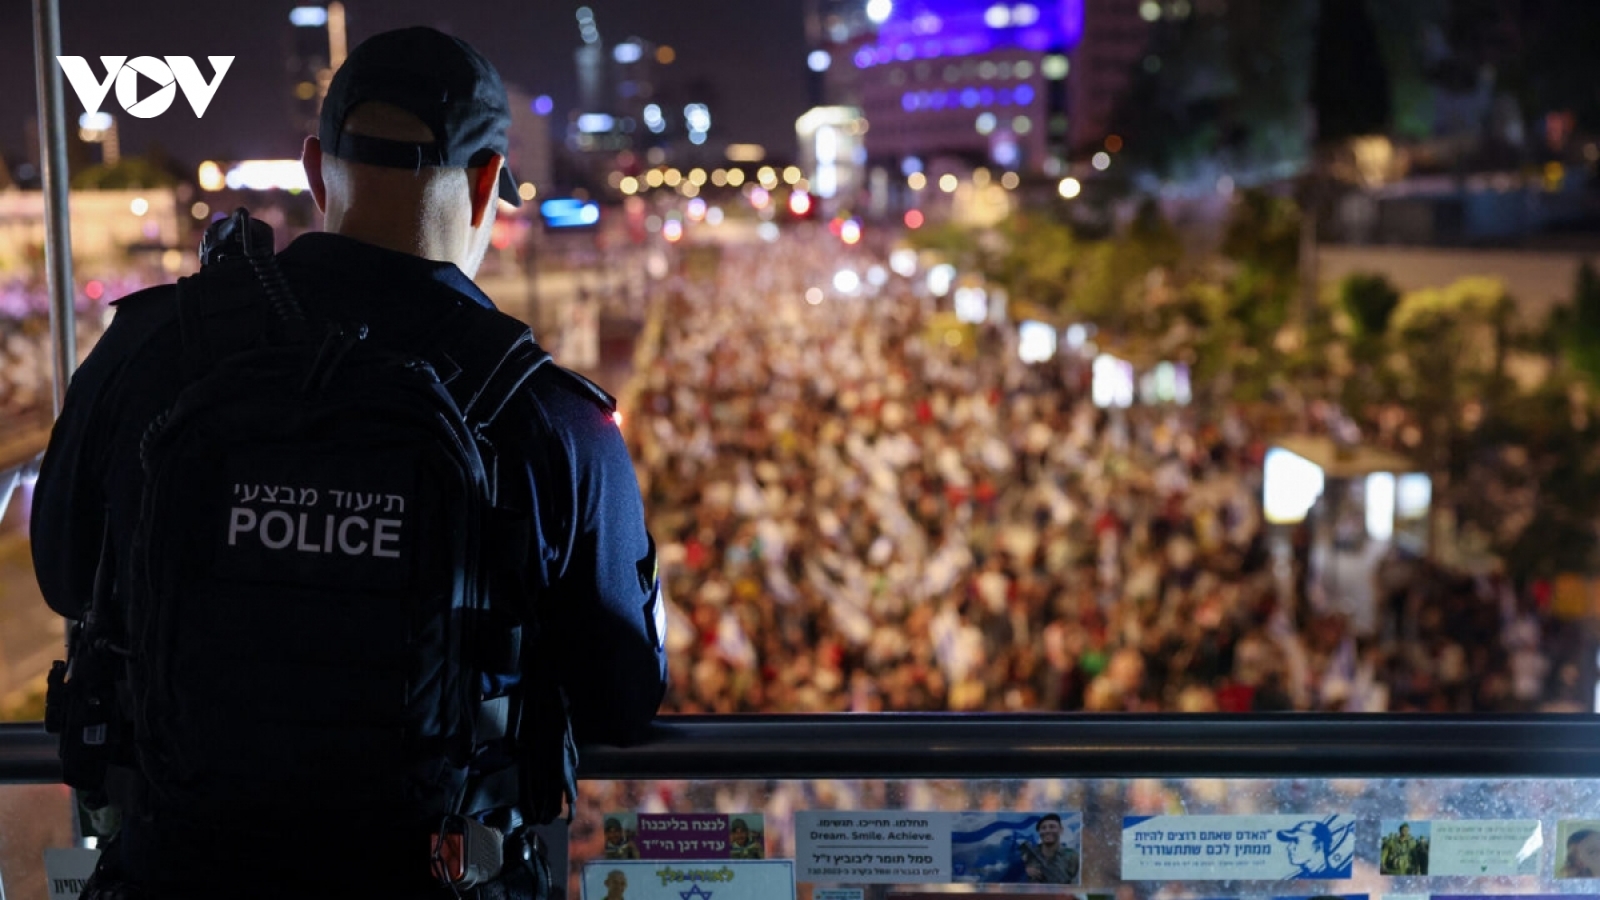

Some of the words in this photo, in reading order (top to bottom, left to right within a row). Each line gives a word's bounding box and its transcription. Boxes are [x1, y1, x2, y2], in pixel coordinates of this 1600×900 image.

[233, 483, 318, 506] מבצעי
[328, 489, 405, 513] תיעוד
[227, 507, 402, 558] POLICE
[692, 817, 726, 831] לנצח
[810, 831, 849, 841] Dream.
[852, 831, 885, 841] Smile.
[888, 831, 934, 841] Achieve.
[1135, 830, 1164, 841] להיות
[1168, 831, 1196, 841] רוצים
[1200, 831, 1232, 841] שאתם
[701, 839, 726, 851] עדי
[1206, 842, 1231, 855] לכם
[1235, 844, 1272, 857] ממתין
[876, 855, 905, 864] תומר
[908, 853, 933, 864] סמל
